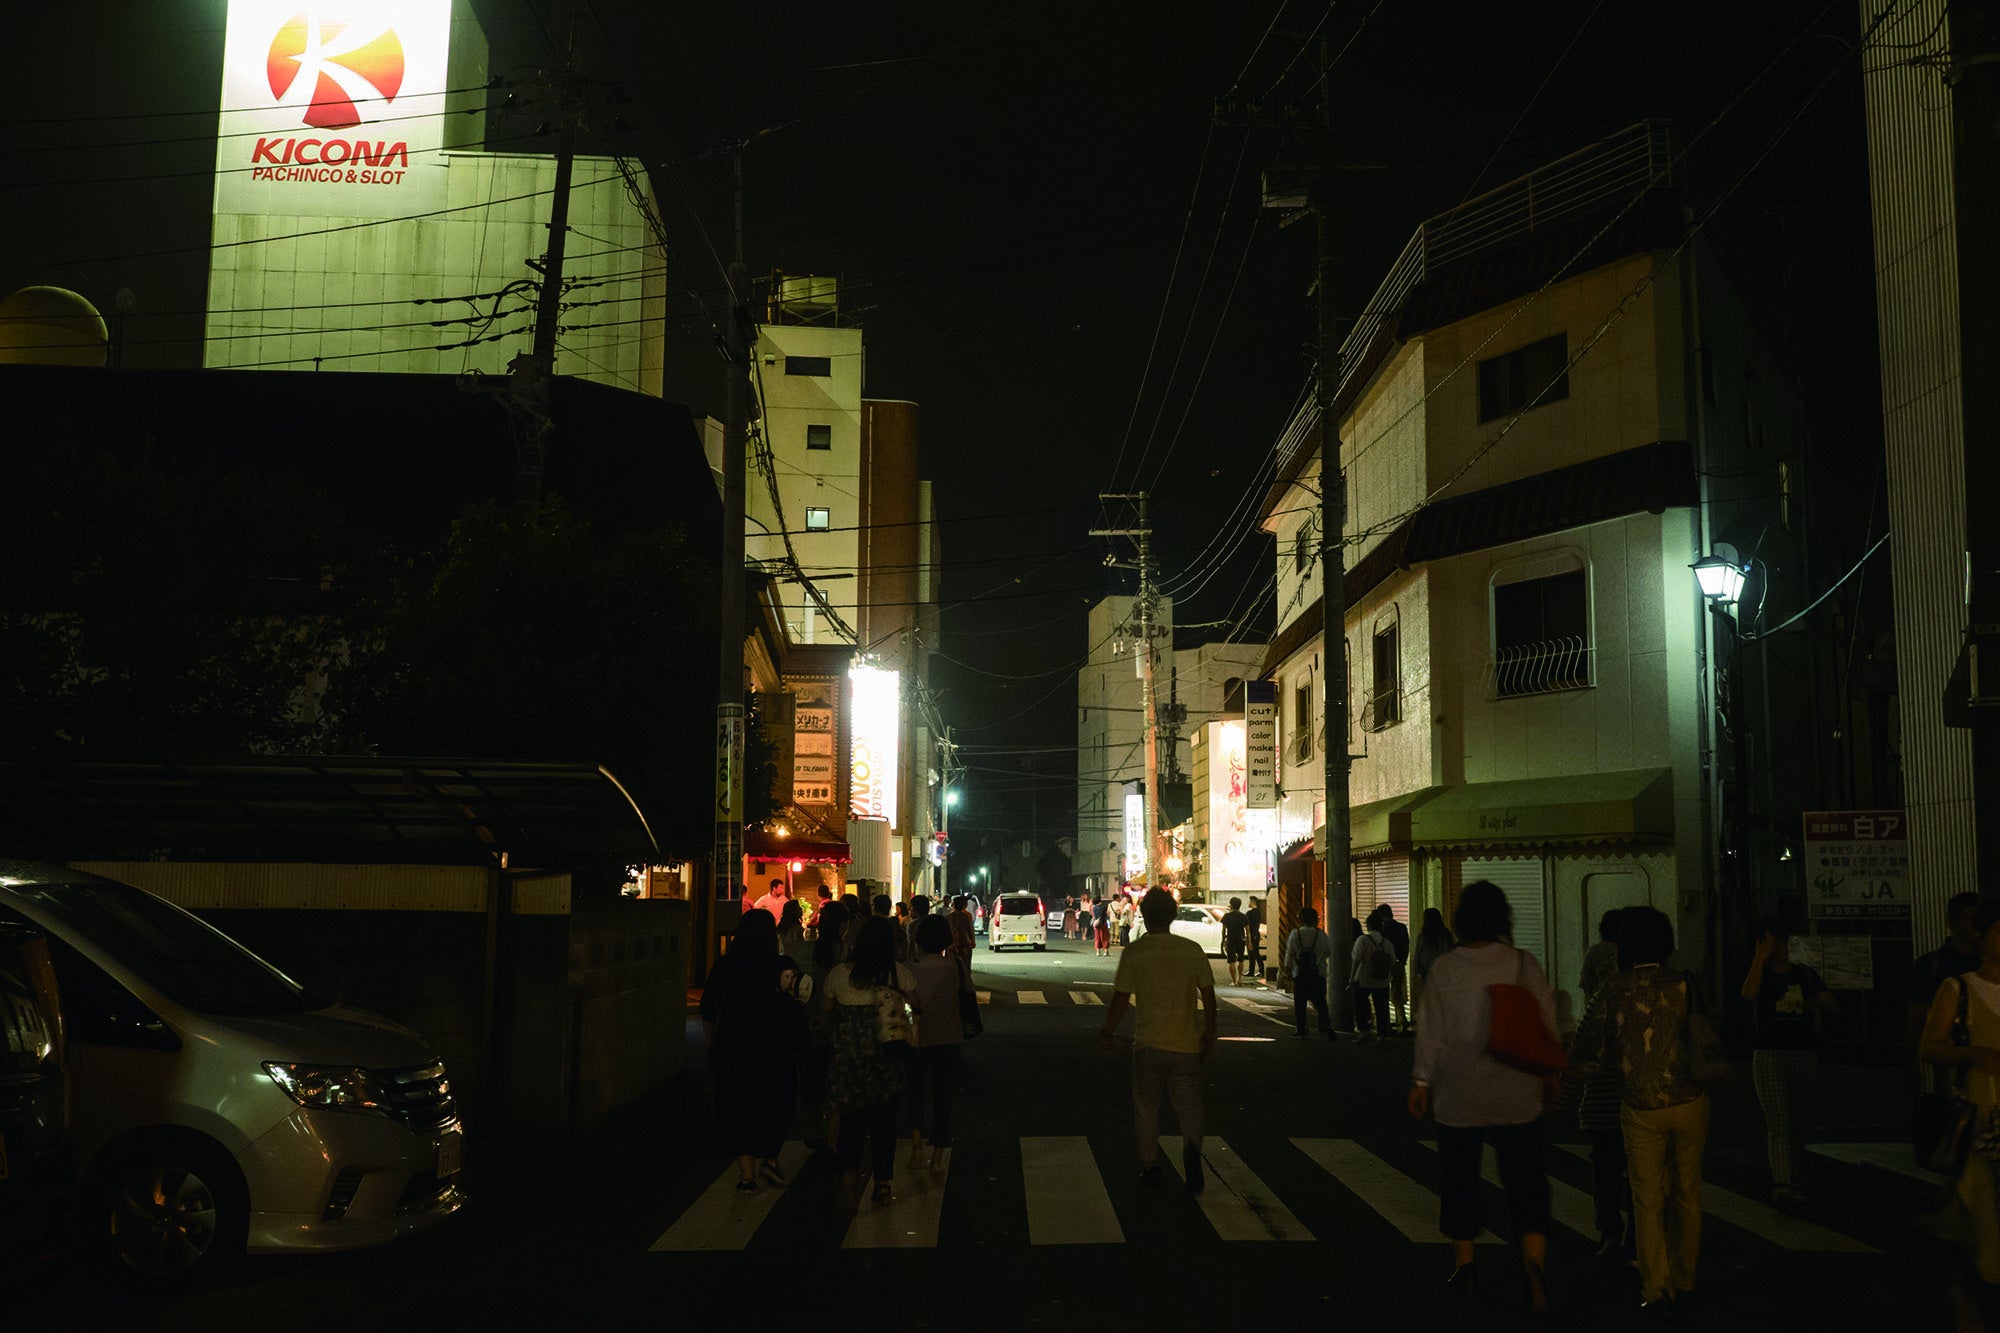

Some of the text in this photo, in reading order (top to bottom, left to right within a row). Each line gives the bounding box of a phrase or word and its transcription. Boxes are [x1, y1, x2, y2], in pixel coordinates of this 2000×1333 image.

[251, 137, 409, 168] KICONA
[252, 166, 405, 185] PACHINCO & SLOT
[1250, 707, 1271, 715] cut
[1251, 731, 1271, 739] color
[1248, 744, 1274, 752] make
[718, 723, 732, 815] みるく
[1255, 791, 1269, 801] 2F
[1861, 879, 1895, 900] JA
